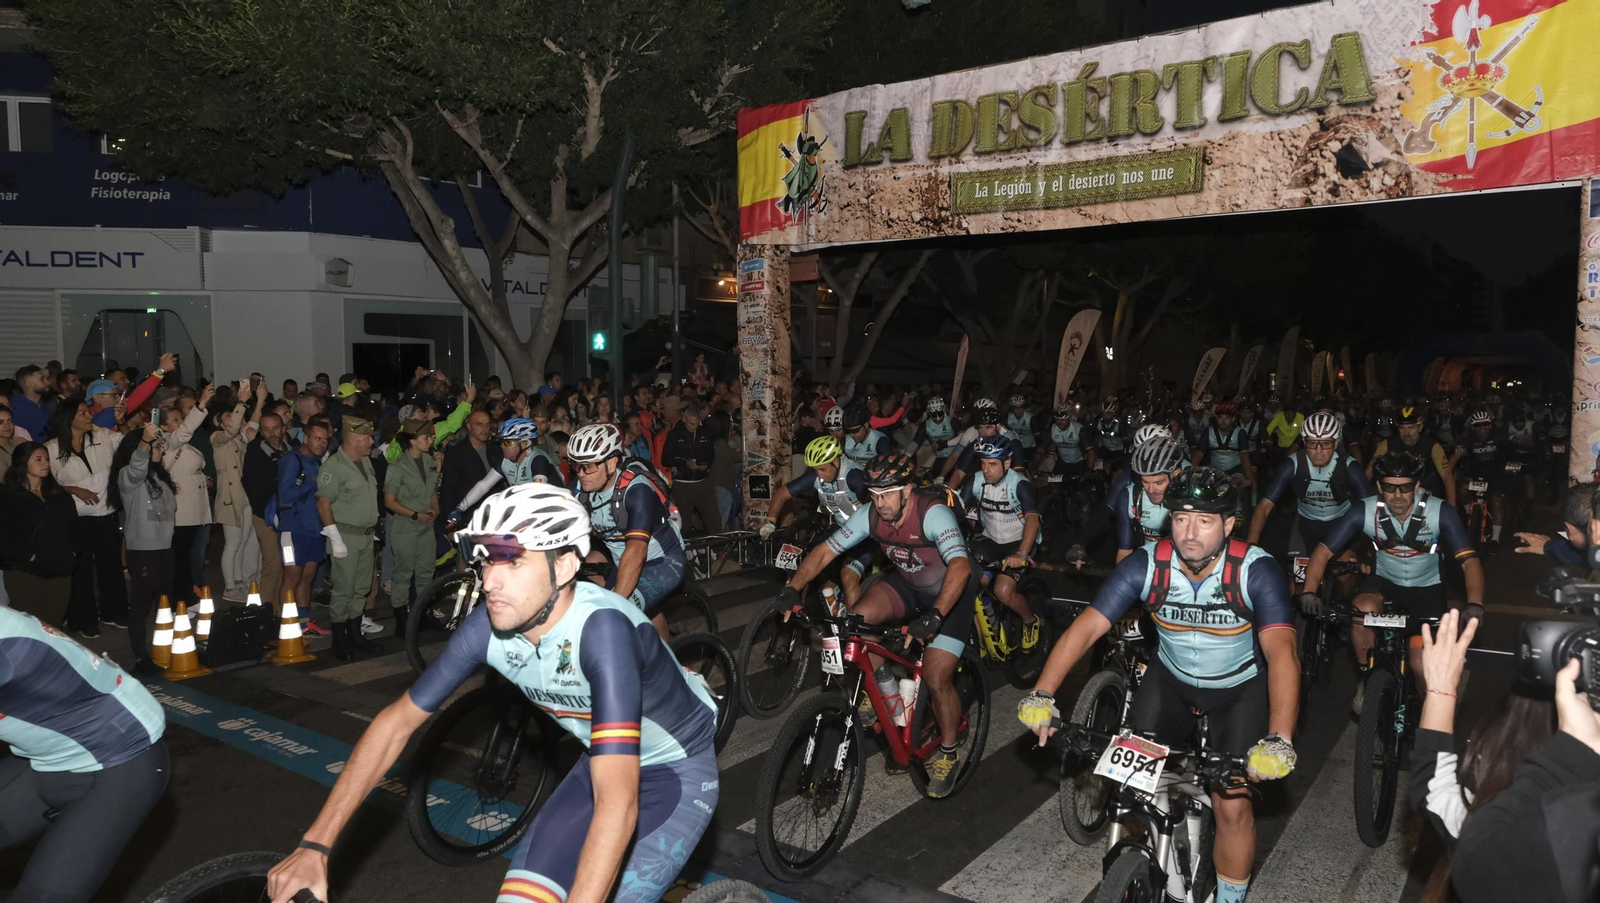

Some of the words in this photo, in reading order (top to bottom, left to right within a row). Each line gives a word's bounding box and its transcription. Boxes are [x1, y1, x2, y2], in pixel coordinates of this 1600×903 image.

[843, 107, 914, 168] LA
[927, 31, 1377, 158] DESÉRTICA
[91, 186, 171, 203] Fisioterapia
[975, 181, 989, 198] La
[993, 175, 1032, 199] Legión
[1038, 181, 1046, 197] y
[1052, 175, 1064, 192] el
[1068, 172, 1116, 191] desierto
[1122, 170, 1144, 184] nos
[1151, 167, 1175, 181] une
[0, 250, 144, 268] ALDENT
[535, 534, 569, 547] KASK
[524, 685, 591, 709] DESÉRTIC
[243, 727, 319, 755] cajamar
[1110, 747, 1159, 777] 6954
